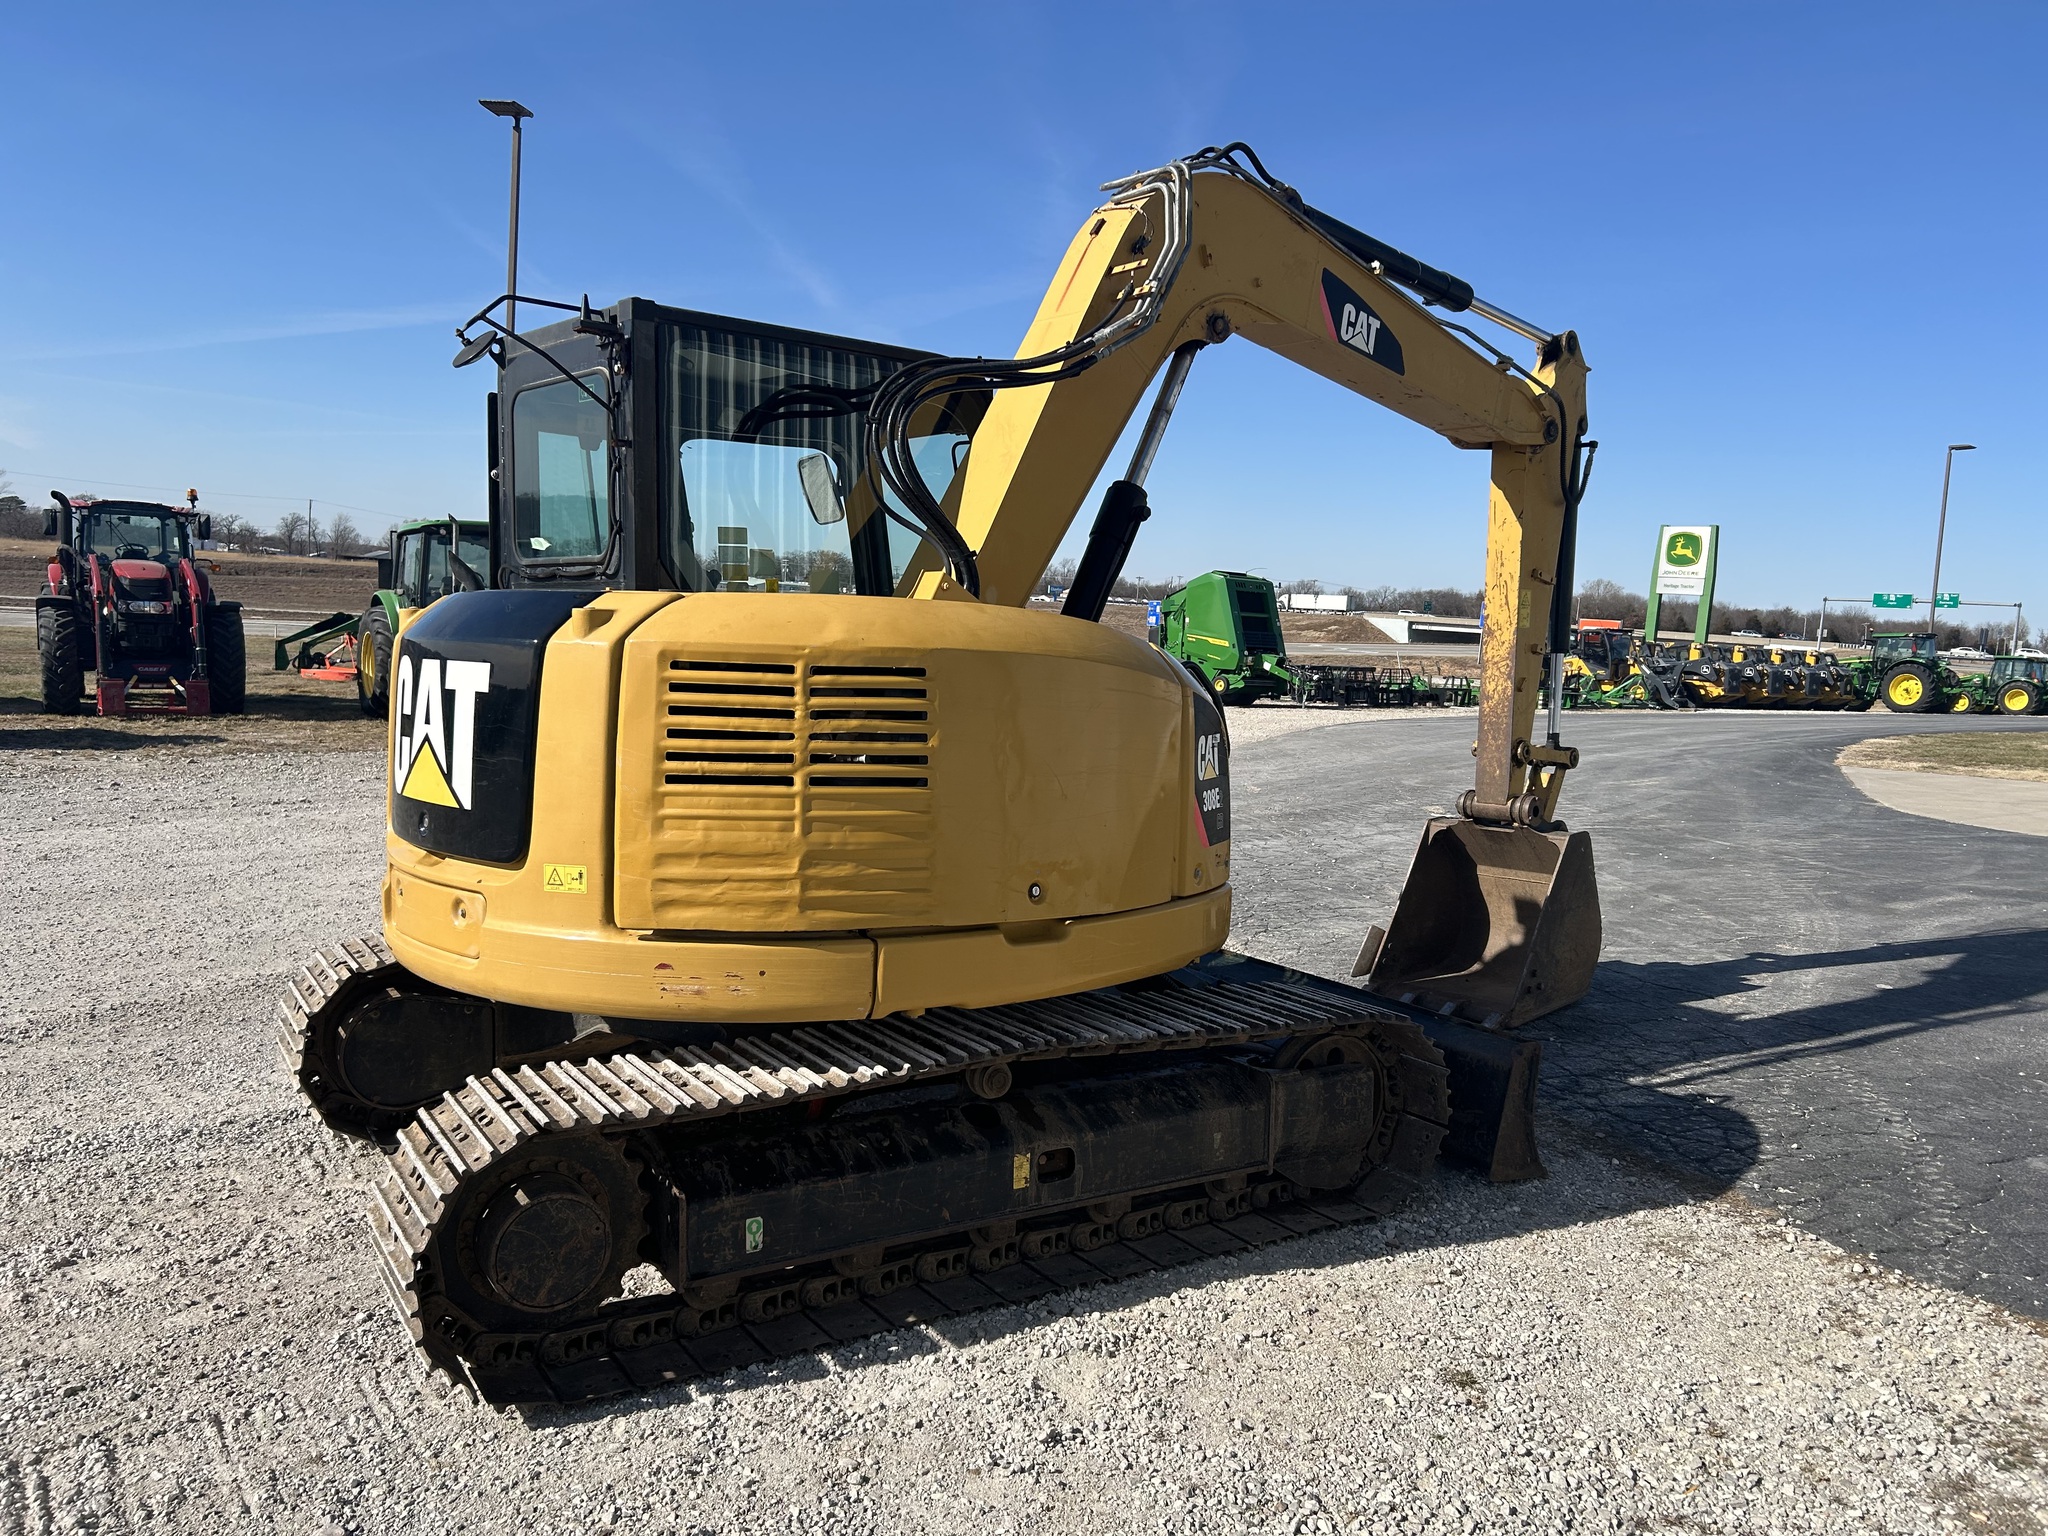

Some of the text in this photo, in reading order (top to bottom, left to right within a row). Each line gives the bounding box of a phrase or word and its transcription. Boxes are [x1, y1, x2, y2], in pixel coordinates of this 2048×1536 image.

[1340, 303, 1381, 355] CAT
[395, 654, 491, 811] CAT
[1198, 733, 1221, 781] CAT
